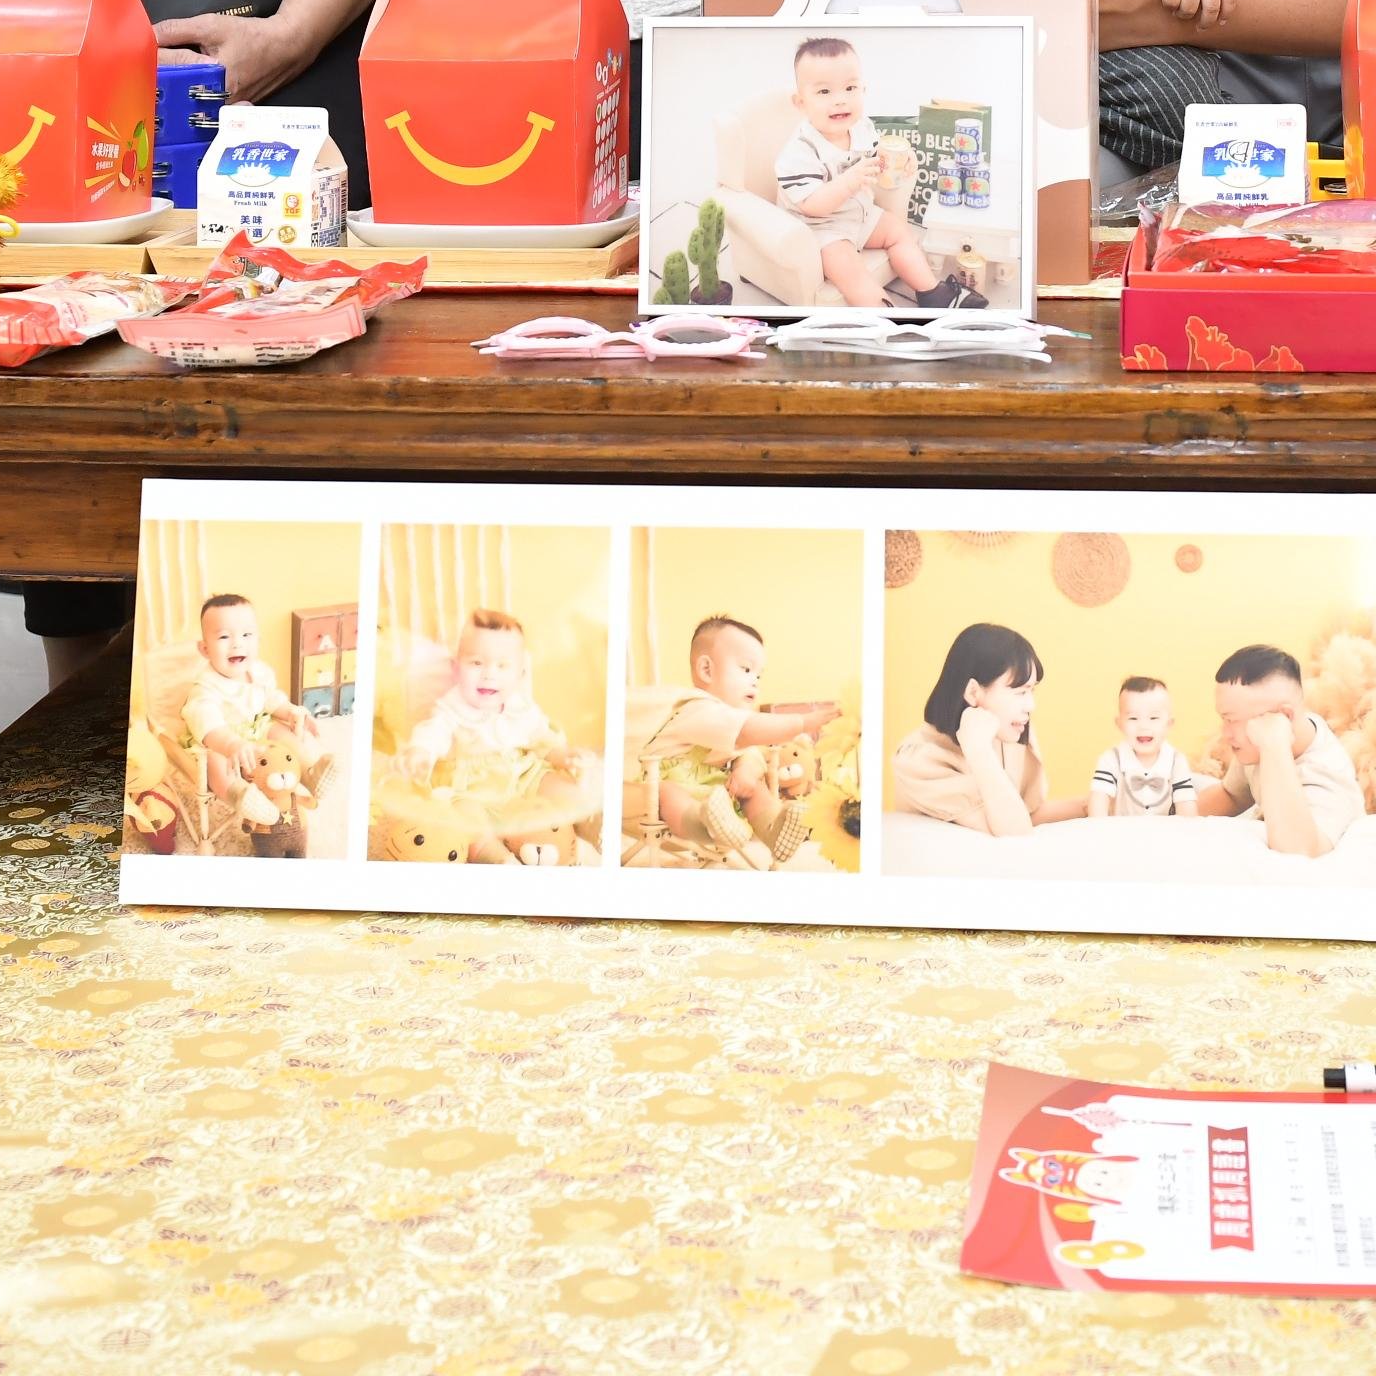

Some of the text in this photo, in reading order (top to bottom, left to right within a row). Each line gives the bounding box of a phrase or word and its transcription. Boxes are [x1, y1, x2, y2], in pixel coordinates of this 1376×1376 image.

[232, 148, 289, 162] 乳香世家
[228, 190, 275, 200] 高品質純鮮乳
[1216, 192, 1269, 201] 高品質純鮮乳
[240, 215, 263, 225] 美味
